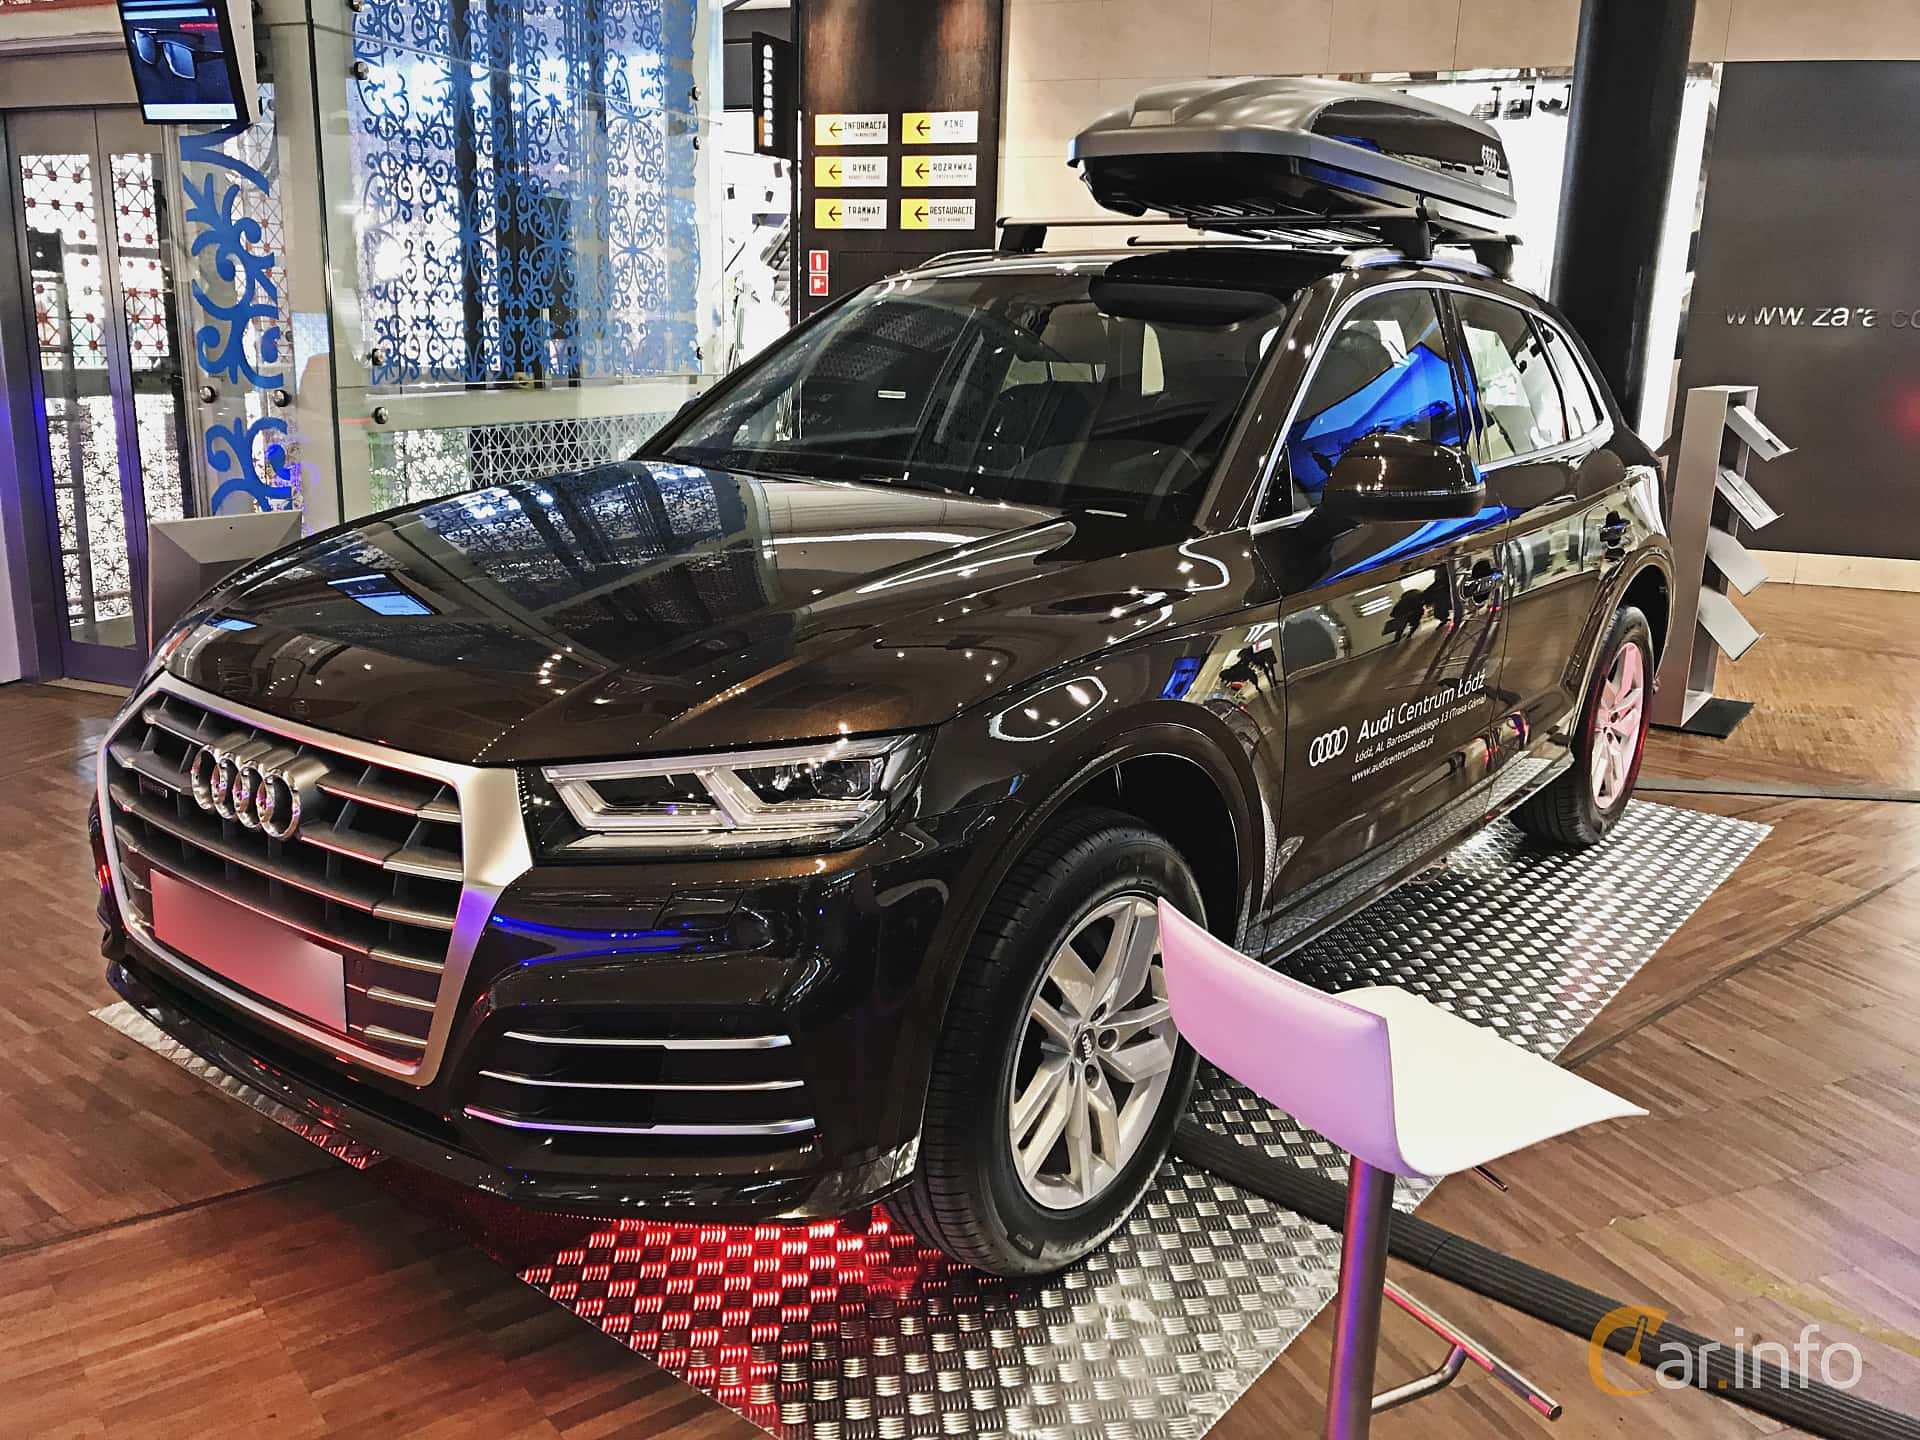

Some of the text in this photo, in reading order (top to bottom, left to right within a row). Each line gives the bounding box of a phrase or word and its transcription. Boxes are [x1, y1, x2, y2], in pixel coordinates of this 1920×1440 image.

[844, 120, 887, 130] INFORMACJA
[943, 119, 964, 128] KINO
[852, 163, 876, 172] RYNEK
[932, 162, 973, 172] ROZRYWKA
[848, 206, 881, 215] TRAMWAJ
[929, 206, 974, 215] RESTAURACJE
[1356, 667, 1486, 744] Audi Centrum Łódź
[1386, 717, 1440, 749] Bartoszewskiego
[1440, 710, 1449, 723] 13
[1351, 734, 1435, 783] www.audicentrumlodz.pl
